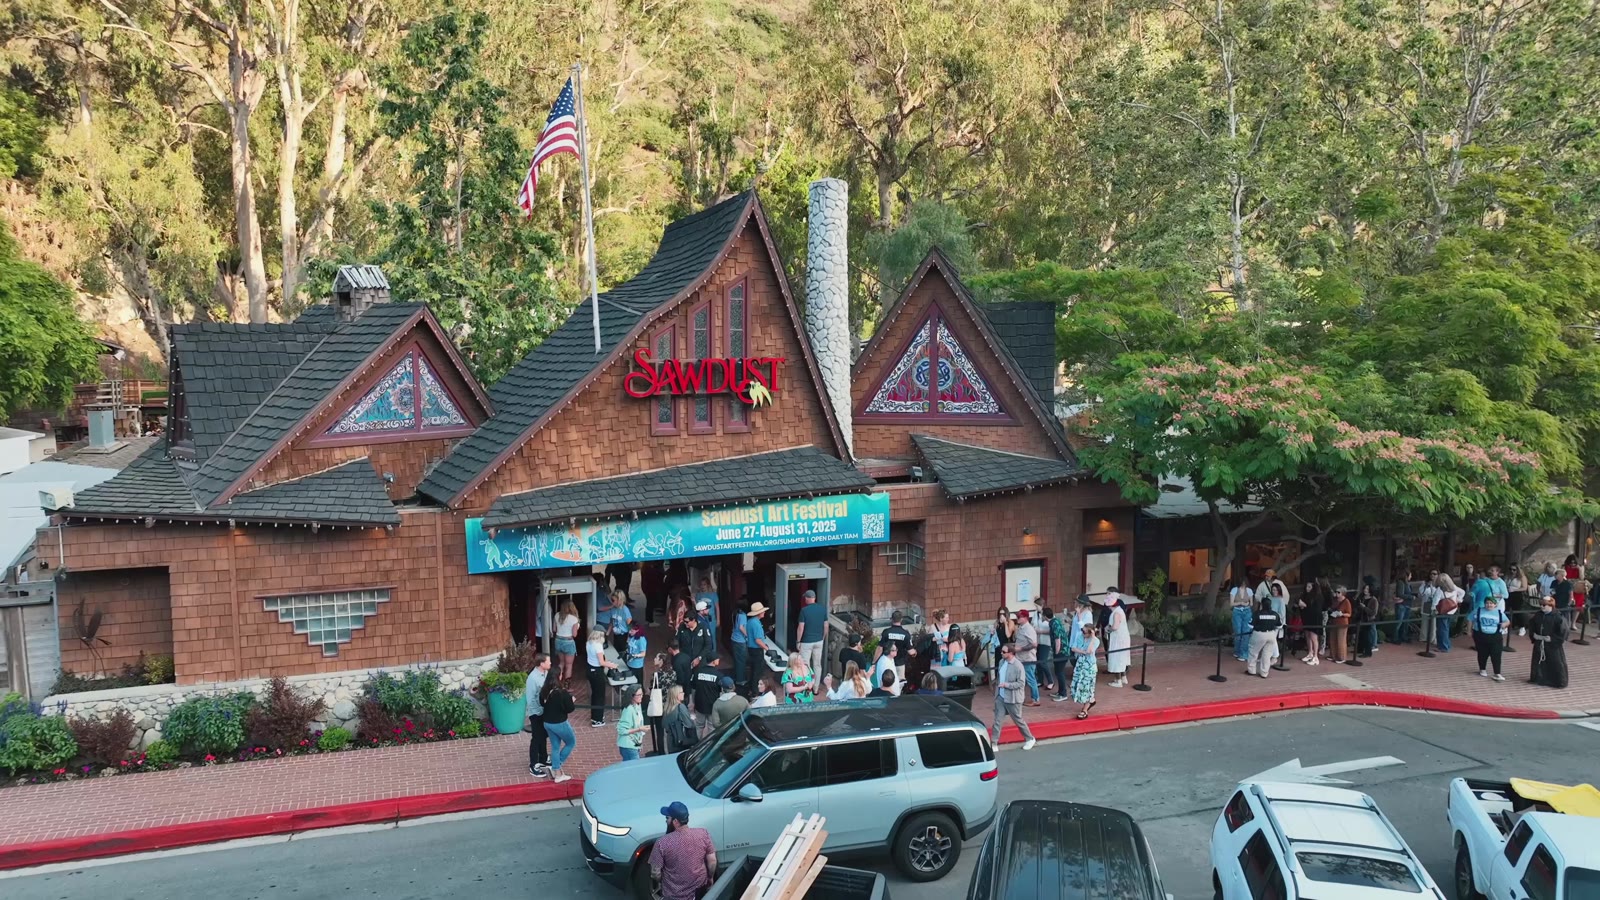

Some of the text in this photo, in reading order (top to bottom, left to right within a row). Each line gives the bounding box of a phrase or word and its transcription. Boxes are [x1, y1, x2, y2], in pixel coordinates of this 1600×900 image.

[624, 347, 786, 404] SAWDUST
[701, 500, 848, 527] Sawdust Art Festival
[693, 537, 806, 552] SAWDUSTARTFESTIVAL.ORG/SUMMER
[827, 533, 843, 541] DAILY
[715, 520, 837, 541] June 27-August 31, 2025
